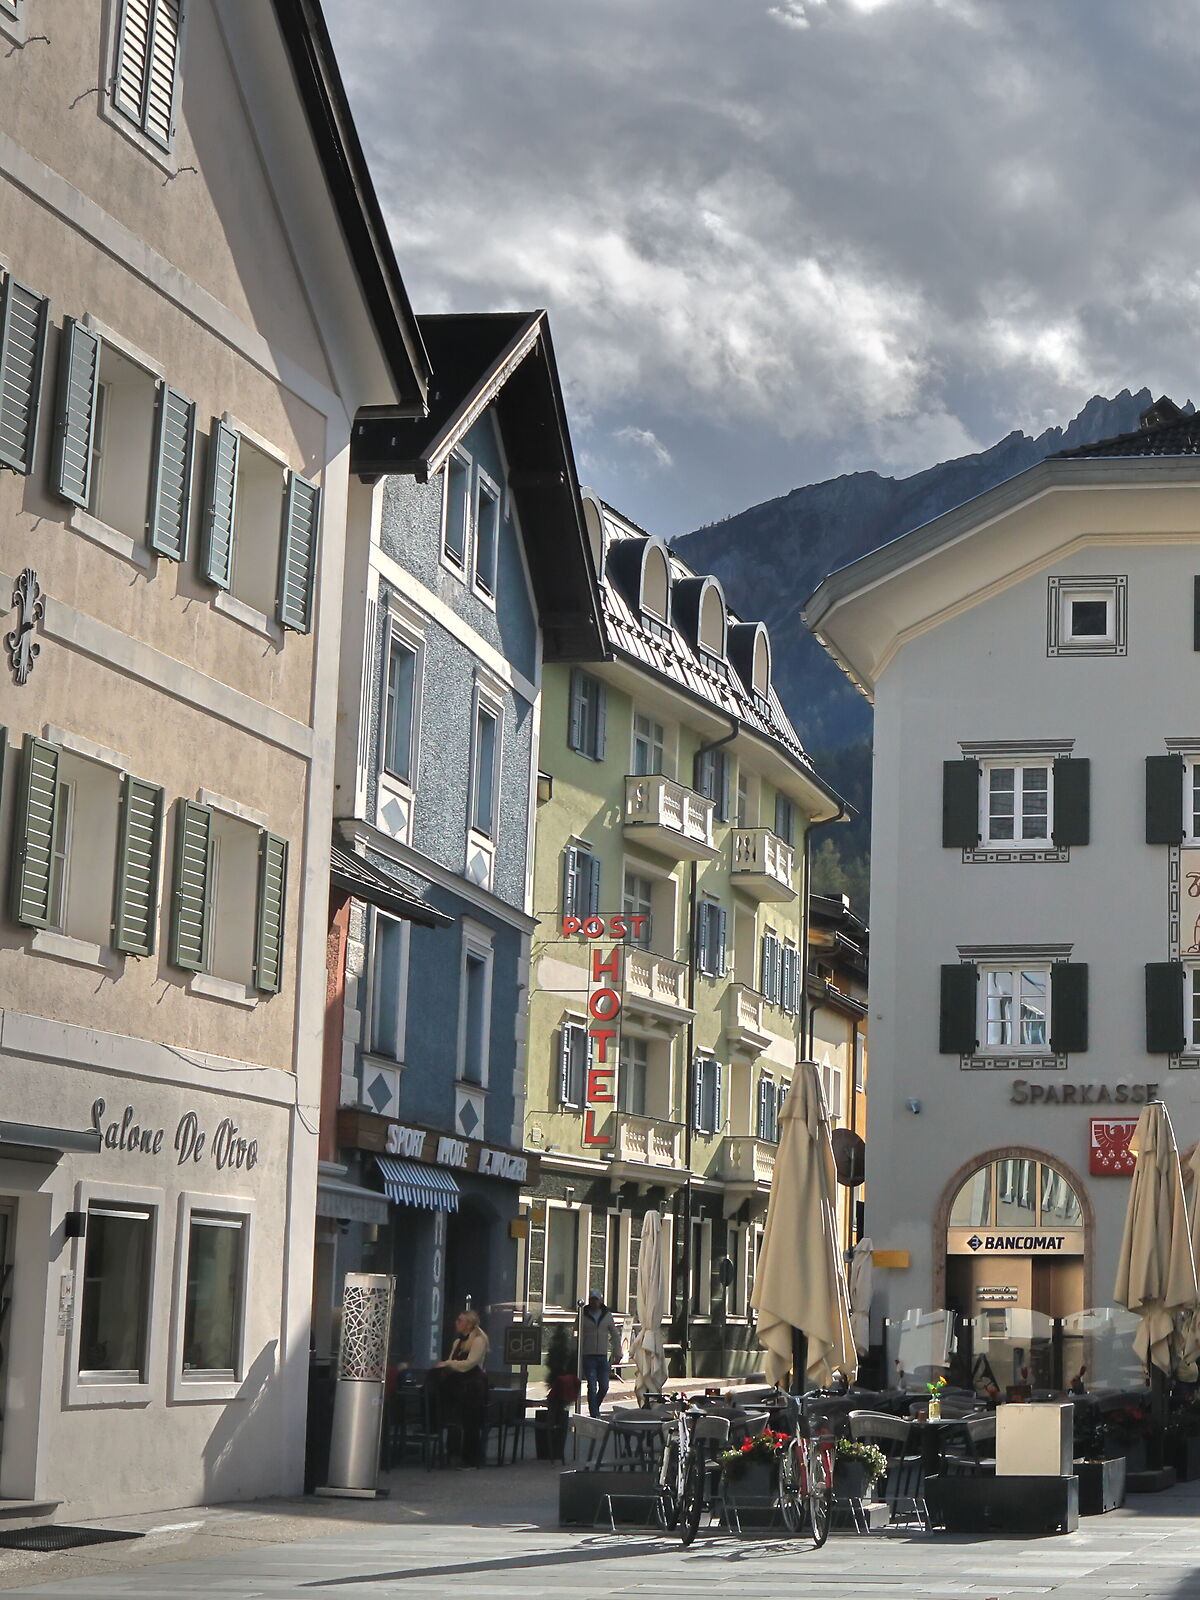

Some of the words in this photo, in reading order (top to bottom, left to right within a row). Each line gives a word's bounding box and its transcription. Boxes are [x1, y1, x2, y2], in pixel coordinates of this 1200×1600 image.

[563, 916, 647, 939] POST
[585, 949, 621, 1144] HOTEL
[1010, 1079, 1159, 1105] SPARKASSE
[85, 1096, 164, 1155] Salone
[174, 1109, 206, 1166] De
[385, 1124, 427, 1159] SPORT
[436, 1137, 470, 1168] MODE
[984, 1236, 1065, 1250] BANCOMAT
